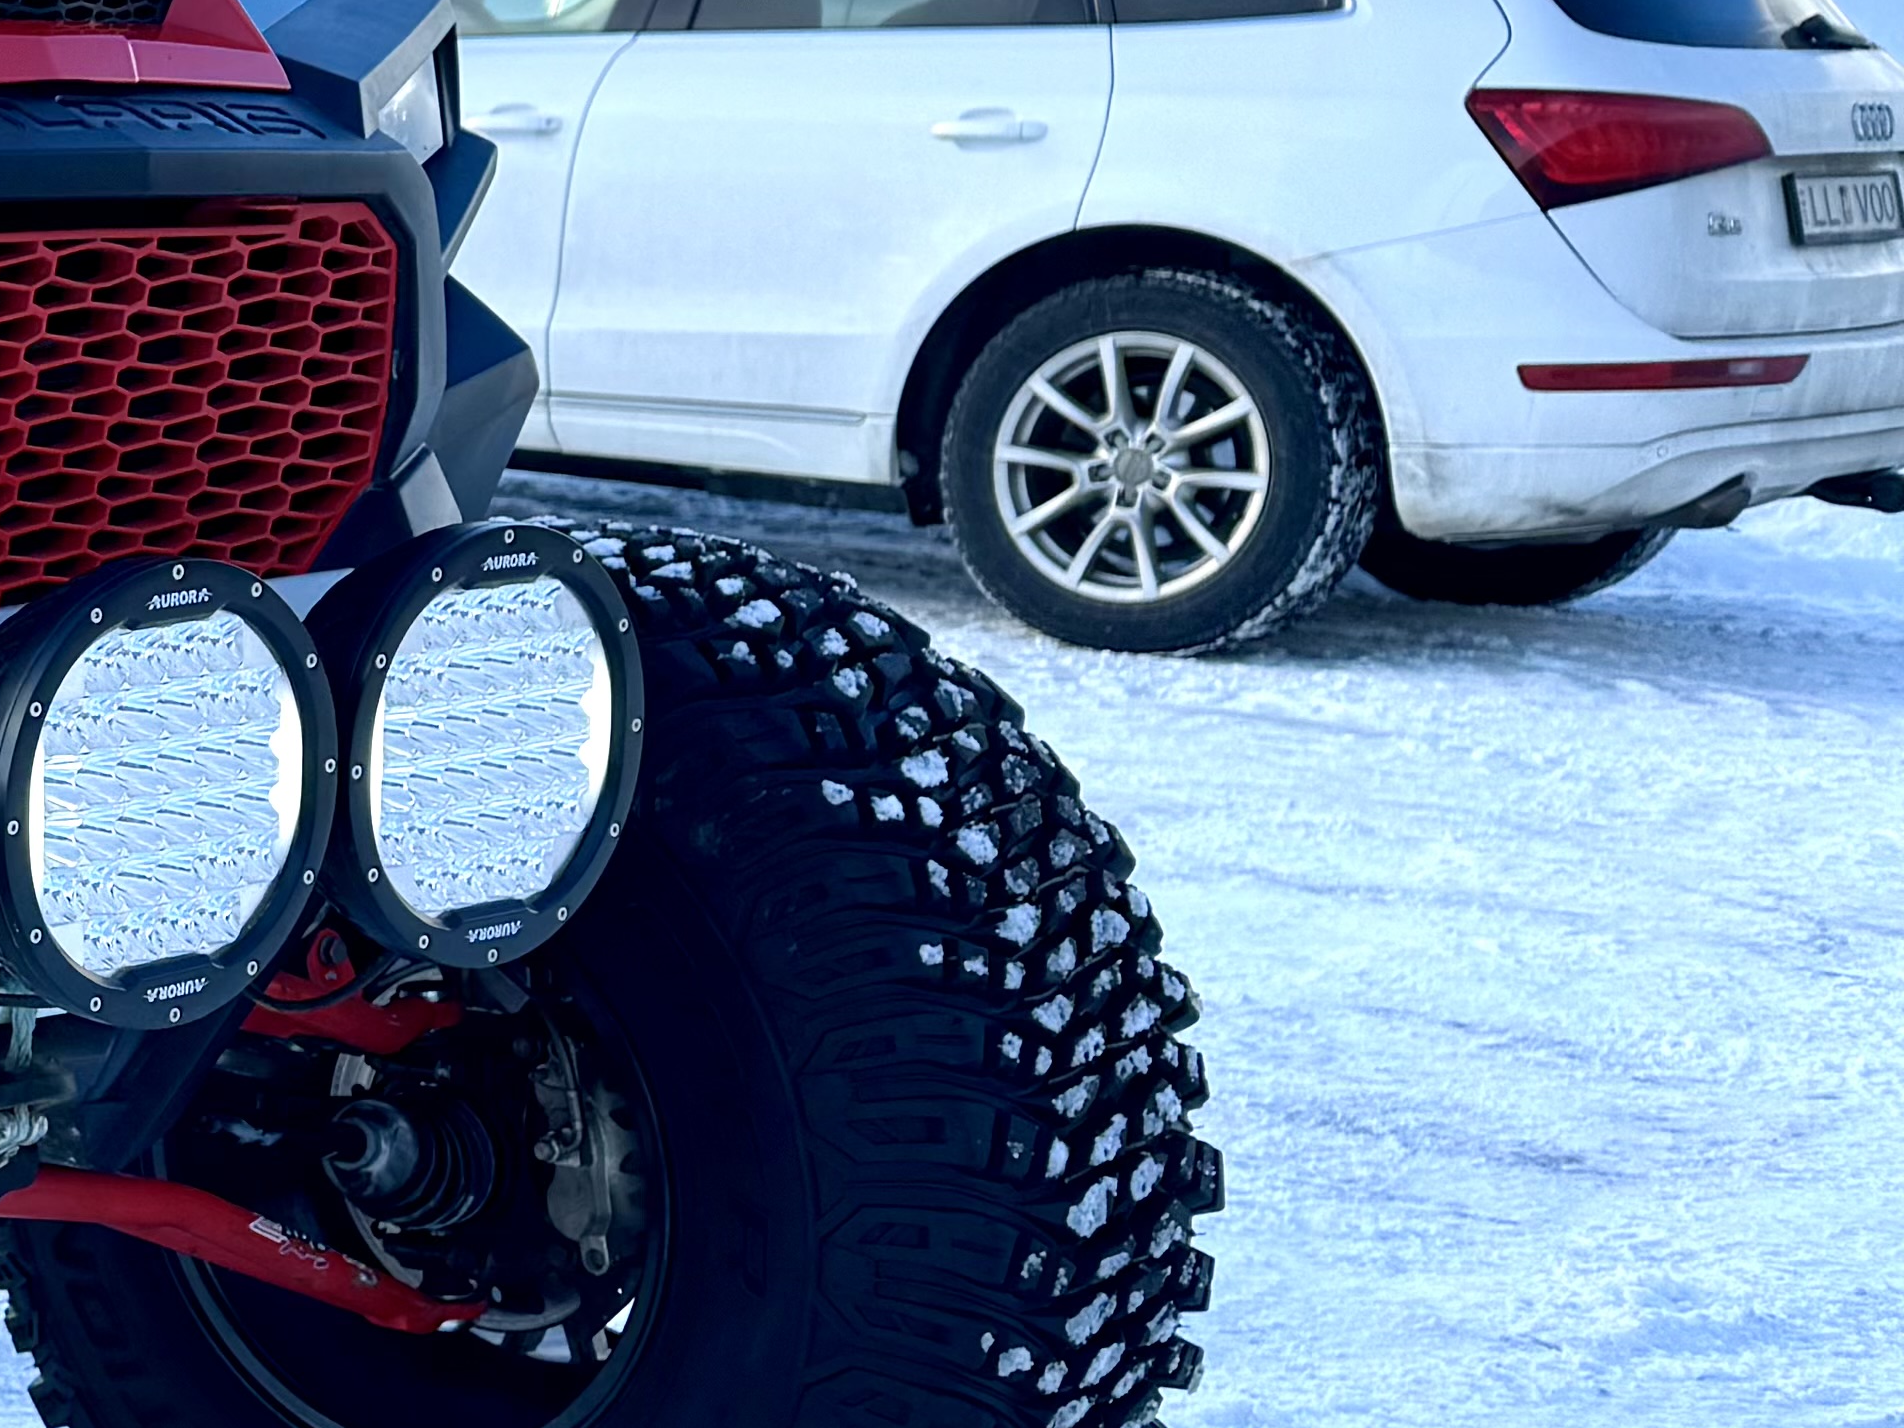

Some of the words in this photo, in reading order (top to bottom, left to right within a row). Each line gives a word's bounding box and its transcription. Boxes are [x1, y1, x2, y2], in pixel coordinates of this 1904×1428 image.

[480, 551, 540, 572] AURORA
[145, 587, 213, 611] AURORA
[465, 920, 523, 943] AURORA
[143, 976, 210, 1003] AURORA
